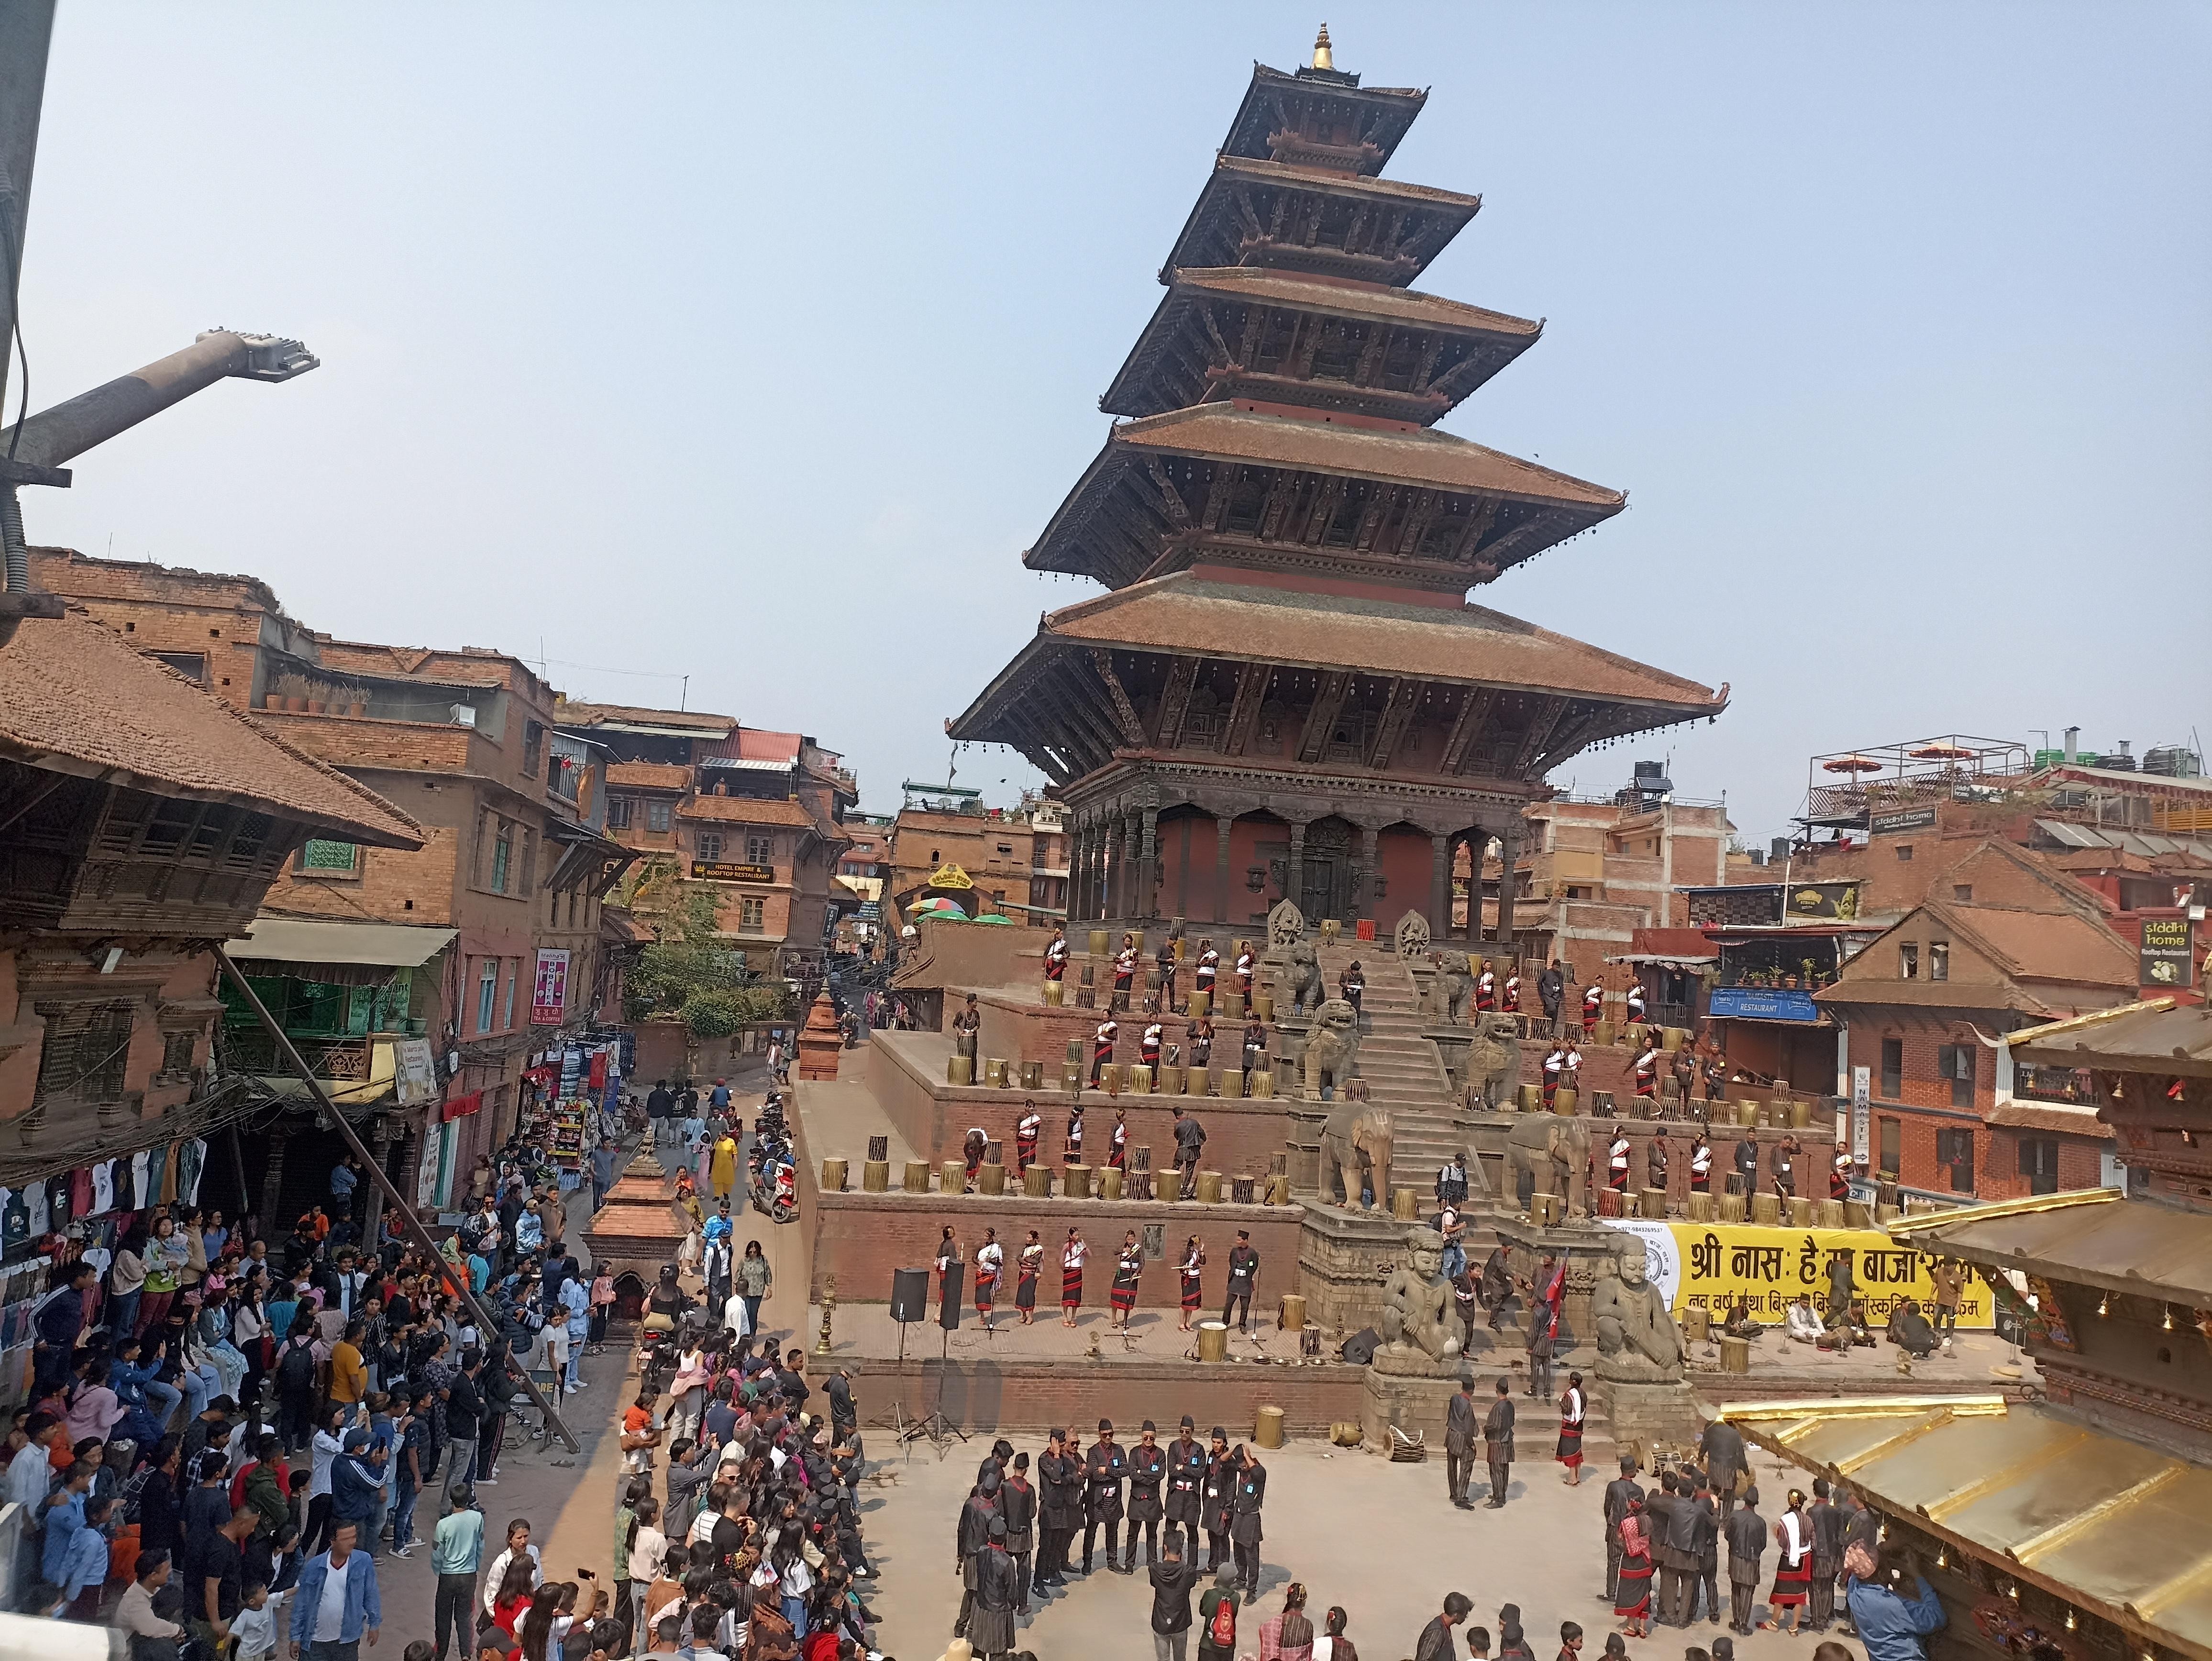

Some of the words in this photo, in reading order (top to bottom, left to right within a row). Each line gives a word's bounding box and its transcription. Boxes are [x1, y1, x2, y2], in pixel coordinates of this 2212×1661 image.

[1875, 815, 1903, 825] siddhi
[1906, 812, 1933, 820] home
[2145, 922, 2189, 933] siddhi
[2146, 934, 2185, 946] home
[2141, 948, 2161, 956] Rooftop
[1740, 1003, 1778, 1012] RESTAURANT
[1858, 1089, 1866, 1141] NAMASTE
[1691, 1233, 1723, 1280] श्री
[1864, 1250, 1918, 1283] बाजा
[1737, 1295, 1765, 1314] था
